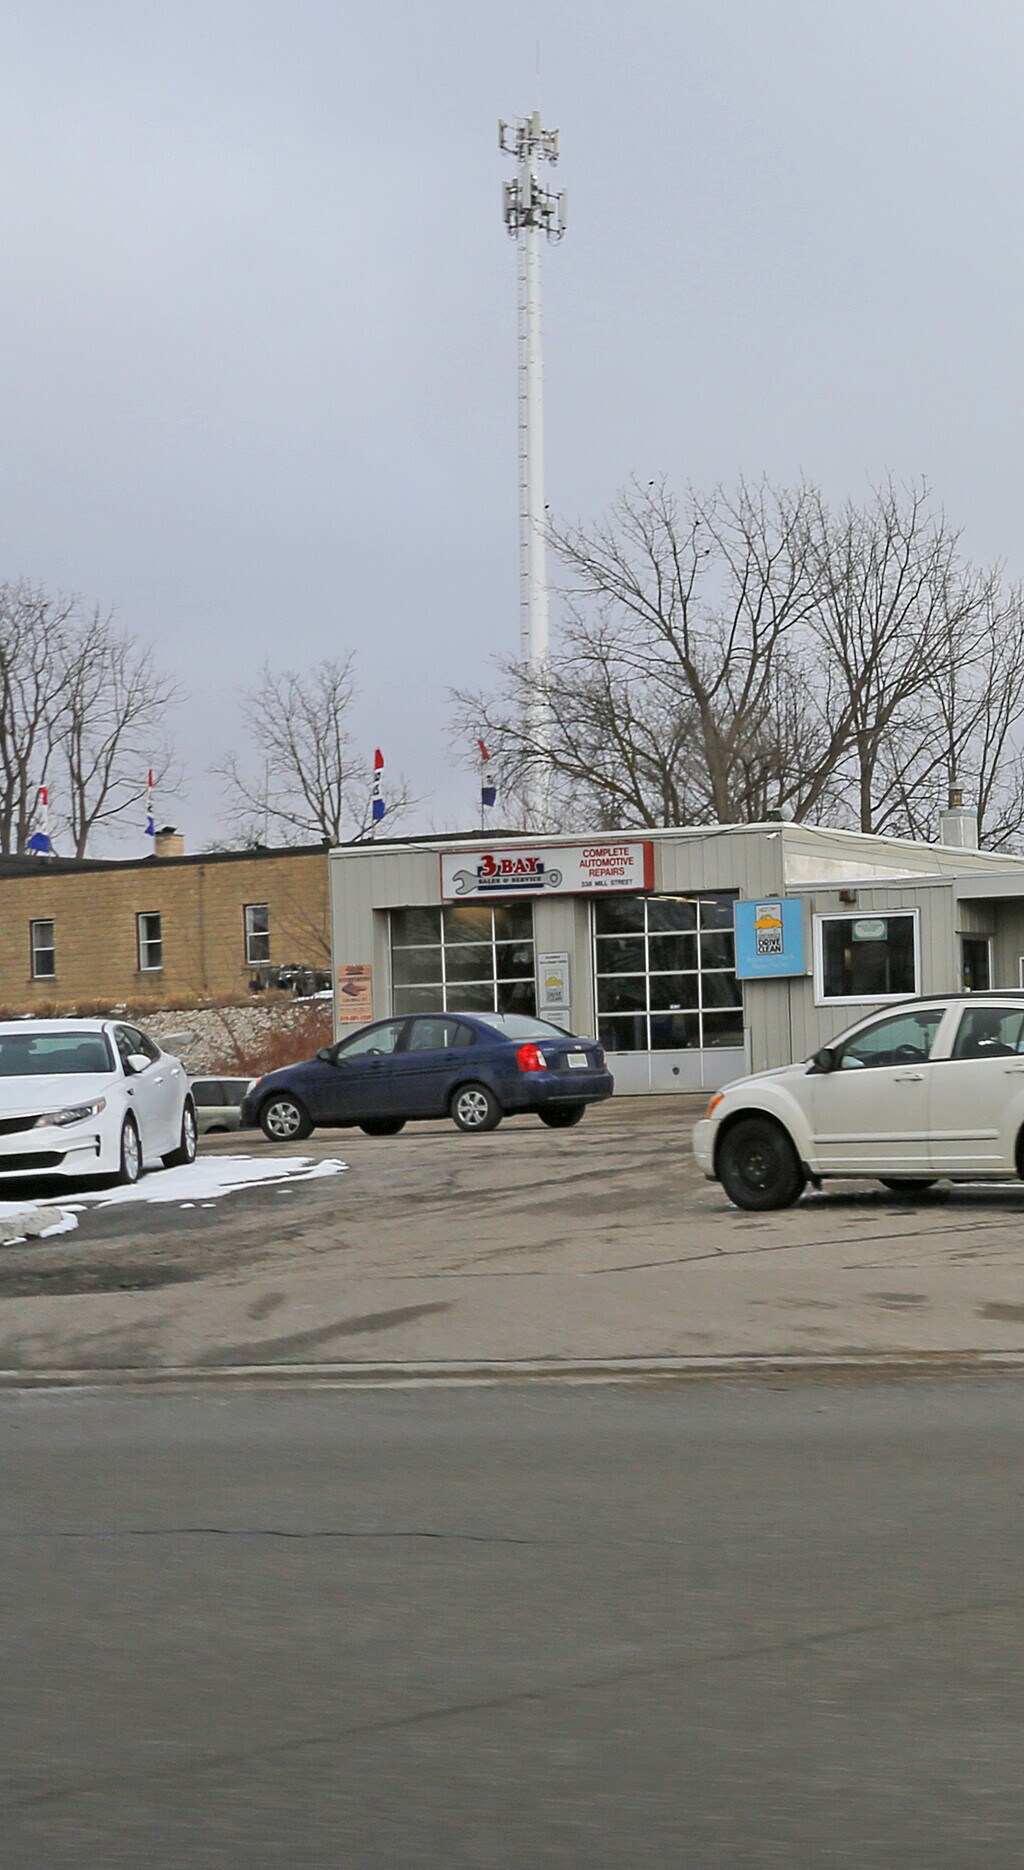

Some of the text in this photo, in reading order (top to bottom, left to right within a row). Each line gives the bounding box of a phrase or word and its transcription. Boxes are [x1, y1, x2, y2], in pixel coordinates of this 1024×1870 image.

[582, 847, 630, 858] COMPLETE
[481, 855, 540, 877] 3 BAY
[579, 857, 634, 868] AUTOMOTIVE
[589, 867, 625, 877] REPAIRS
[758, 938, 781, 946] DRIVE
[758, 945, 781, 953] CLEAN
